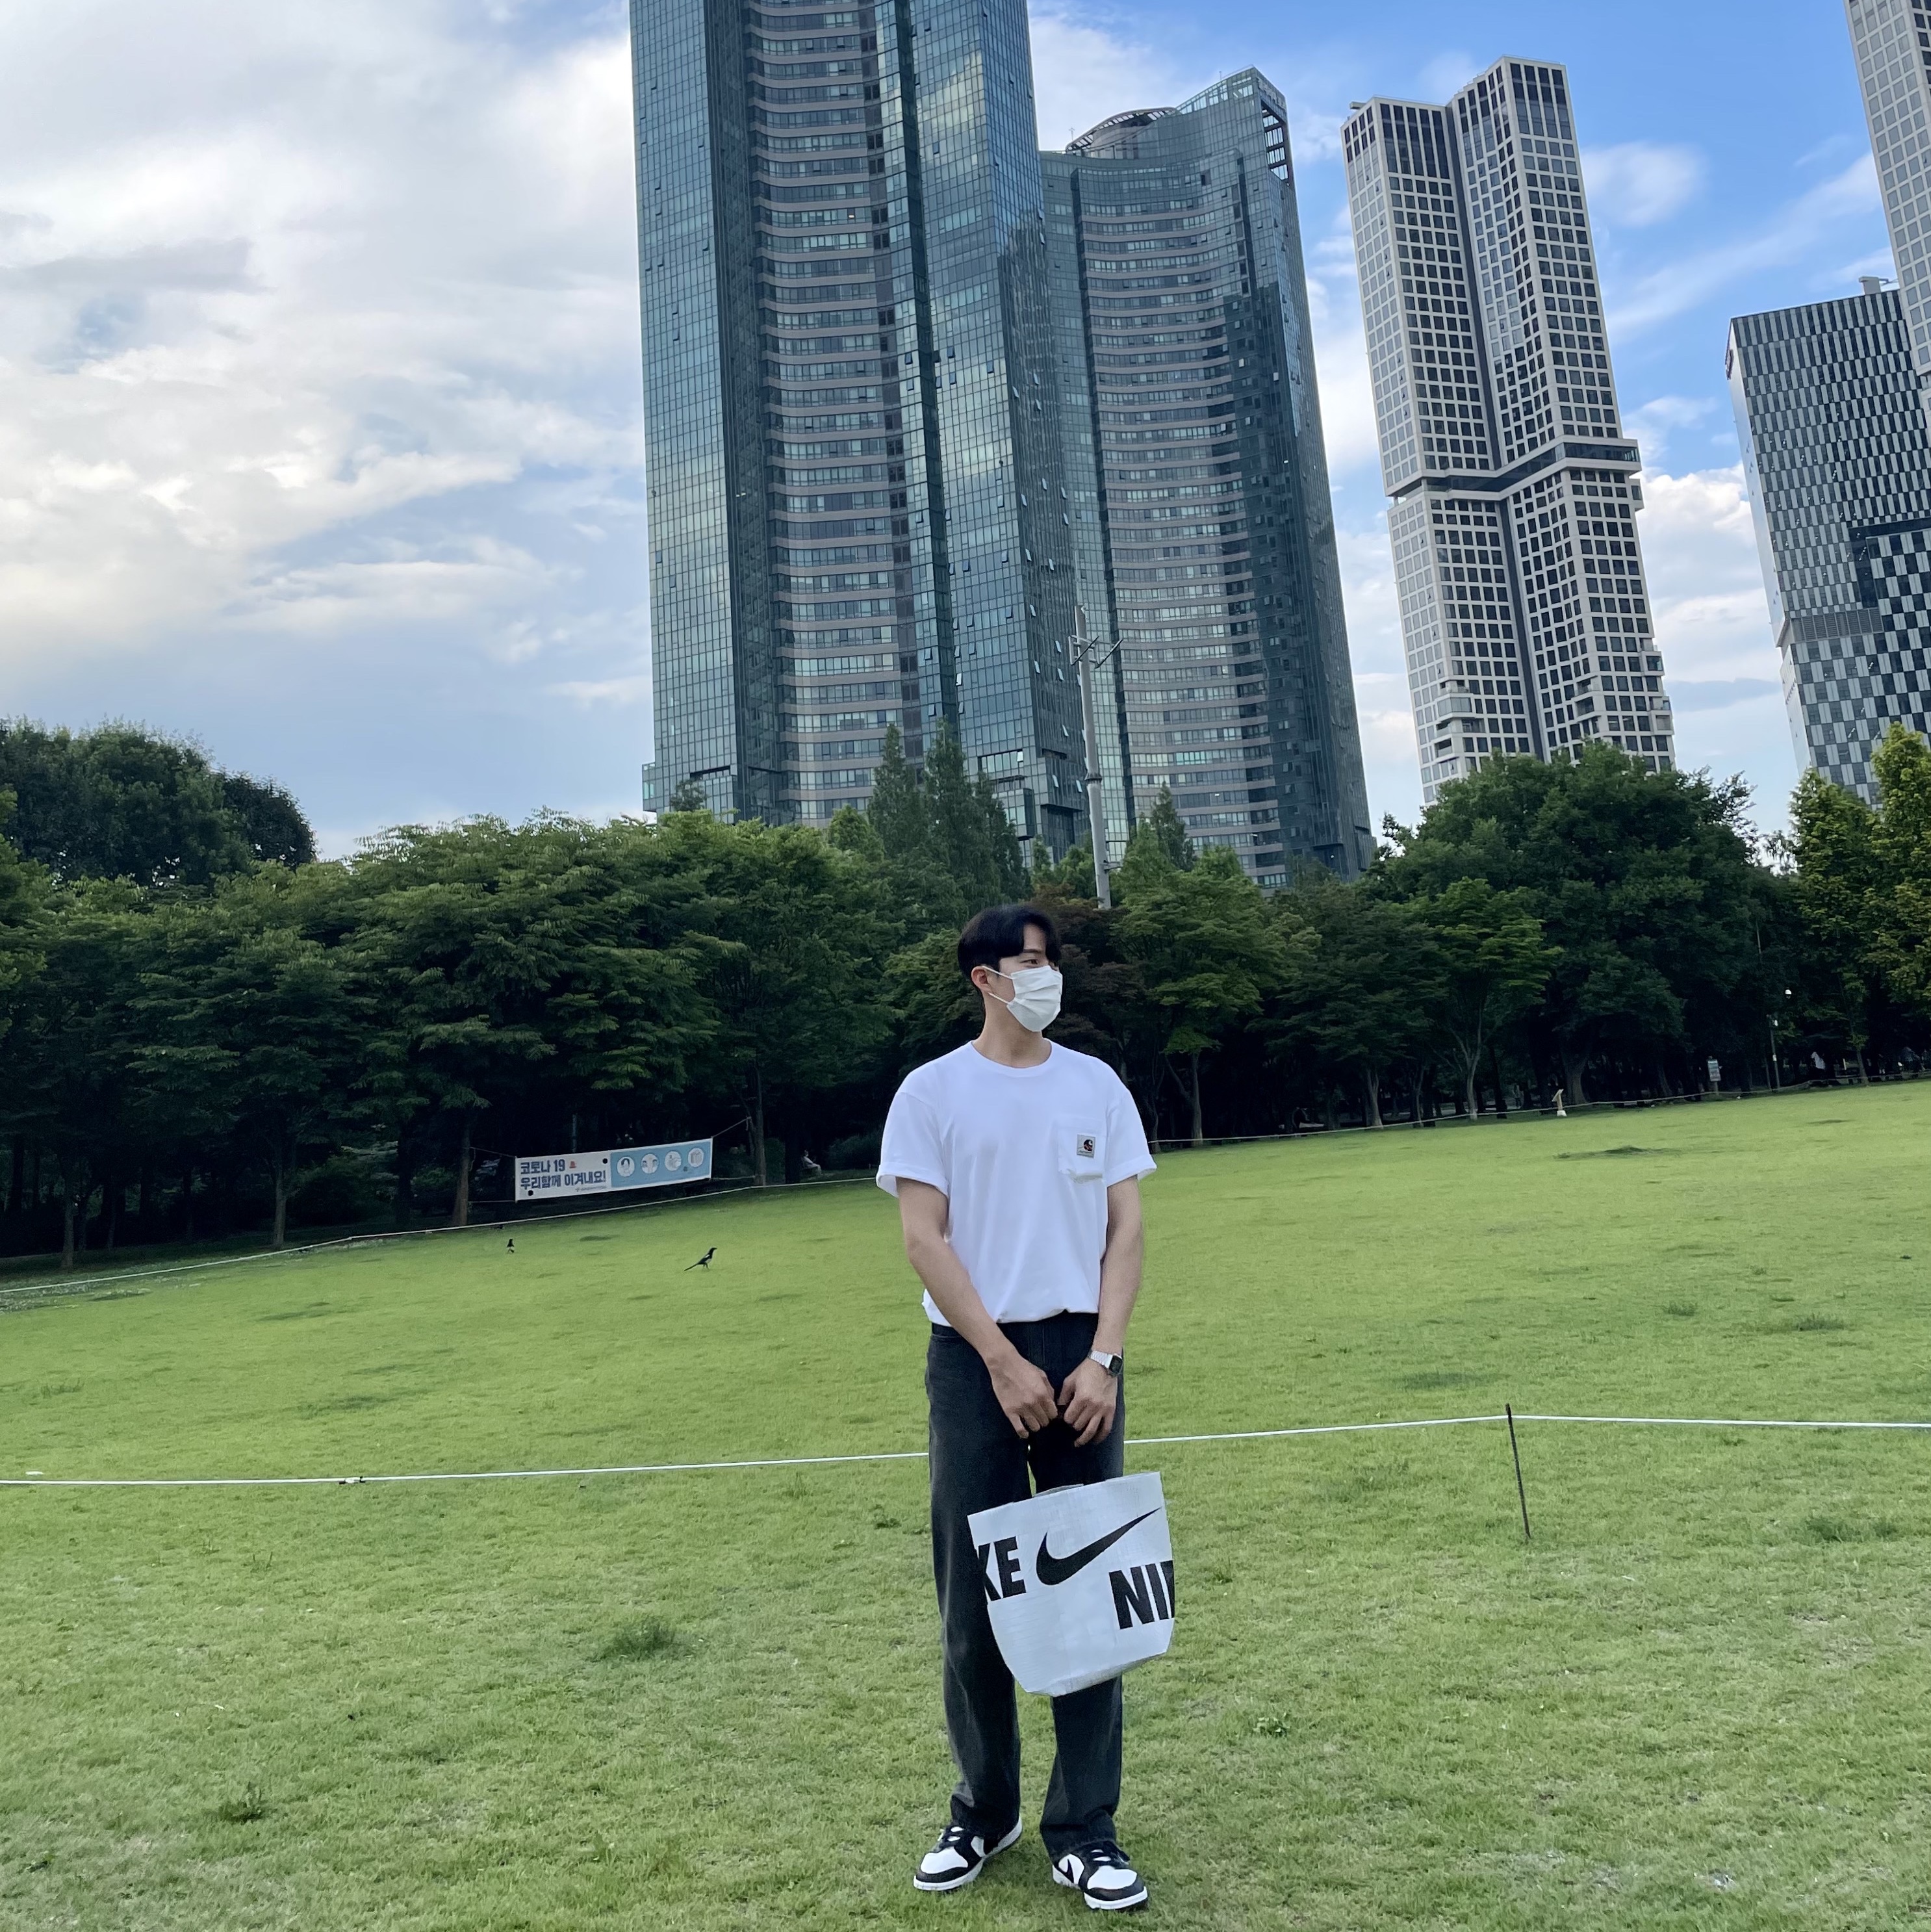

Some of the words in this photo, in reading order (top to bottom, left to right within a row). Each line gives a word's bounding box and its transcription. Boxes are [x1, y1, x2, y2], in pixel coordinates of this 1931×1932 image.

[520, 1160, 551, 1174] 코로나
[554, 1159, 565, 1172] 19
[520, 1175, 561, 1190] 우리함께
[564, 1170, 606, 1186] 이겨내요!
